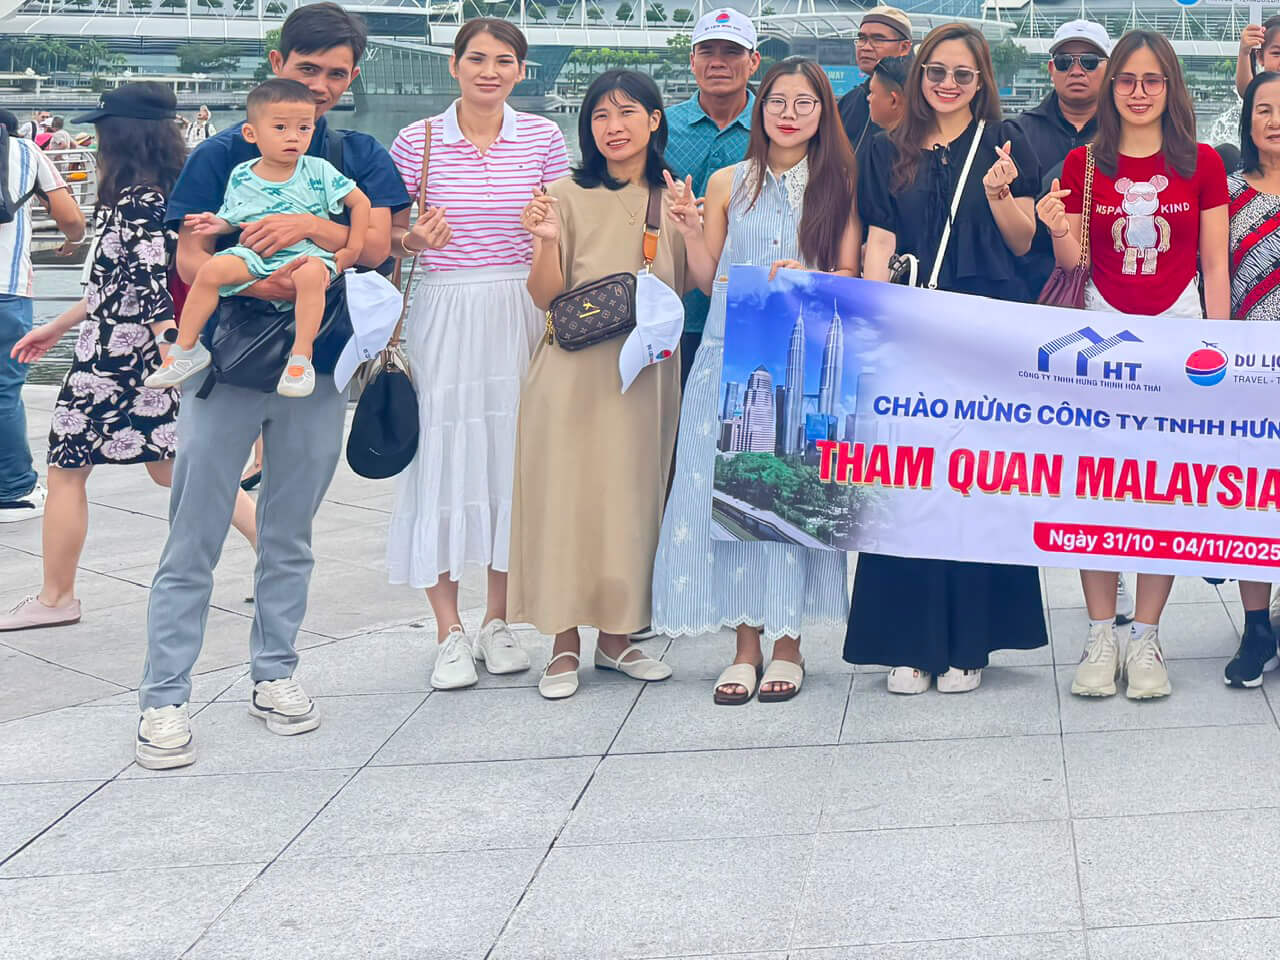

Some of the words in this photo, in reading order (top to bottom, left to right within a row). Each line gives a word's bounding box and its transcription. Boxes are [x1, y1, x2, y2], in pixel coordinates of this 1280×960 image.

[1160, 202, 1190, 214] KIND
[1235, 354, 1255, 367] DU
[1104, 361, 1142, 381] HT
[1054, 375, 1074, 384] TNHH
[1233, 375, 1268, 384] TRAVEL
[873, 392, 948, 418] CHÀO
[954, 395, 1032, 423] MỪNG
[1037, 401, 1111, 428] CÔNG
[1116, 413, 1147, 430] TY
[1154, 416, 1225, 435] TNHH
[816, 440, 935, 489] THAM
[947, 448, 1063, 497] QUAN
[1049, 529, 1097, 552] Ngày
[1102, 532, 1154, 552] 31/10
